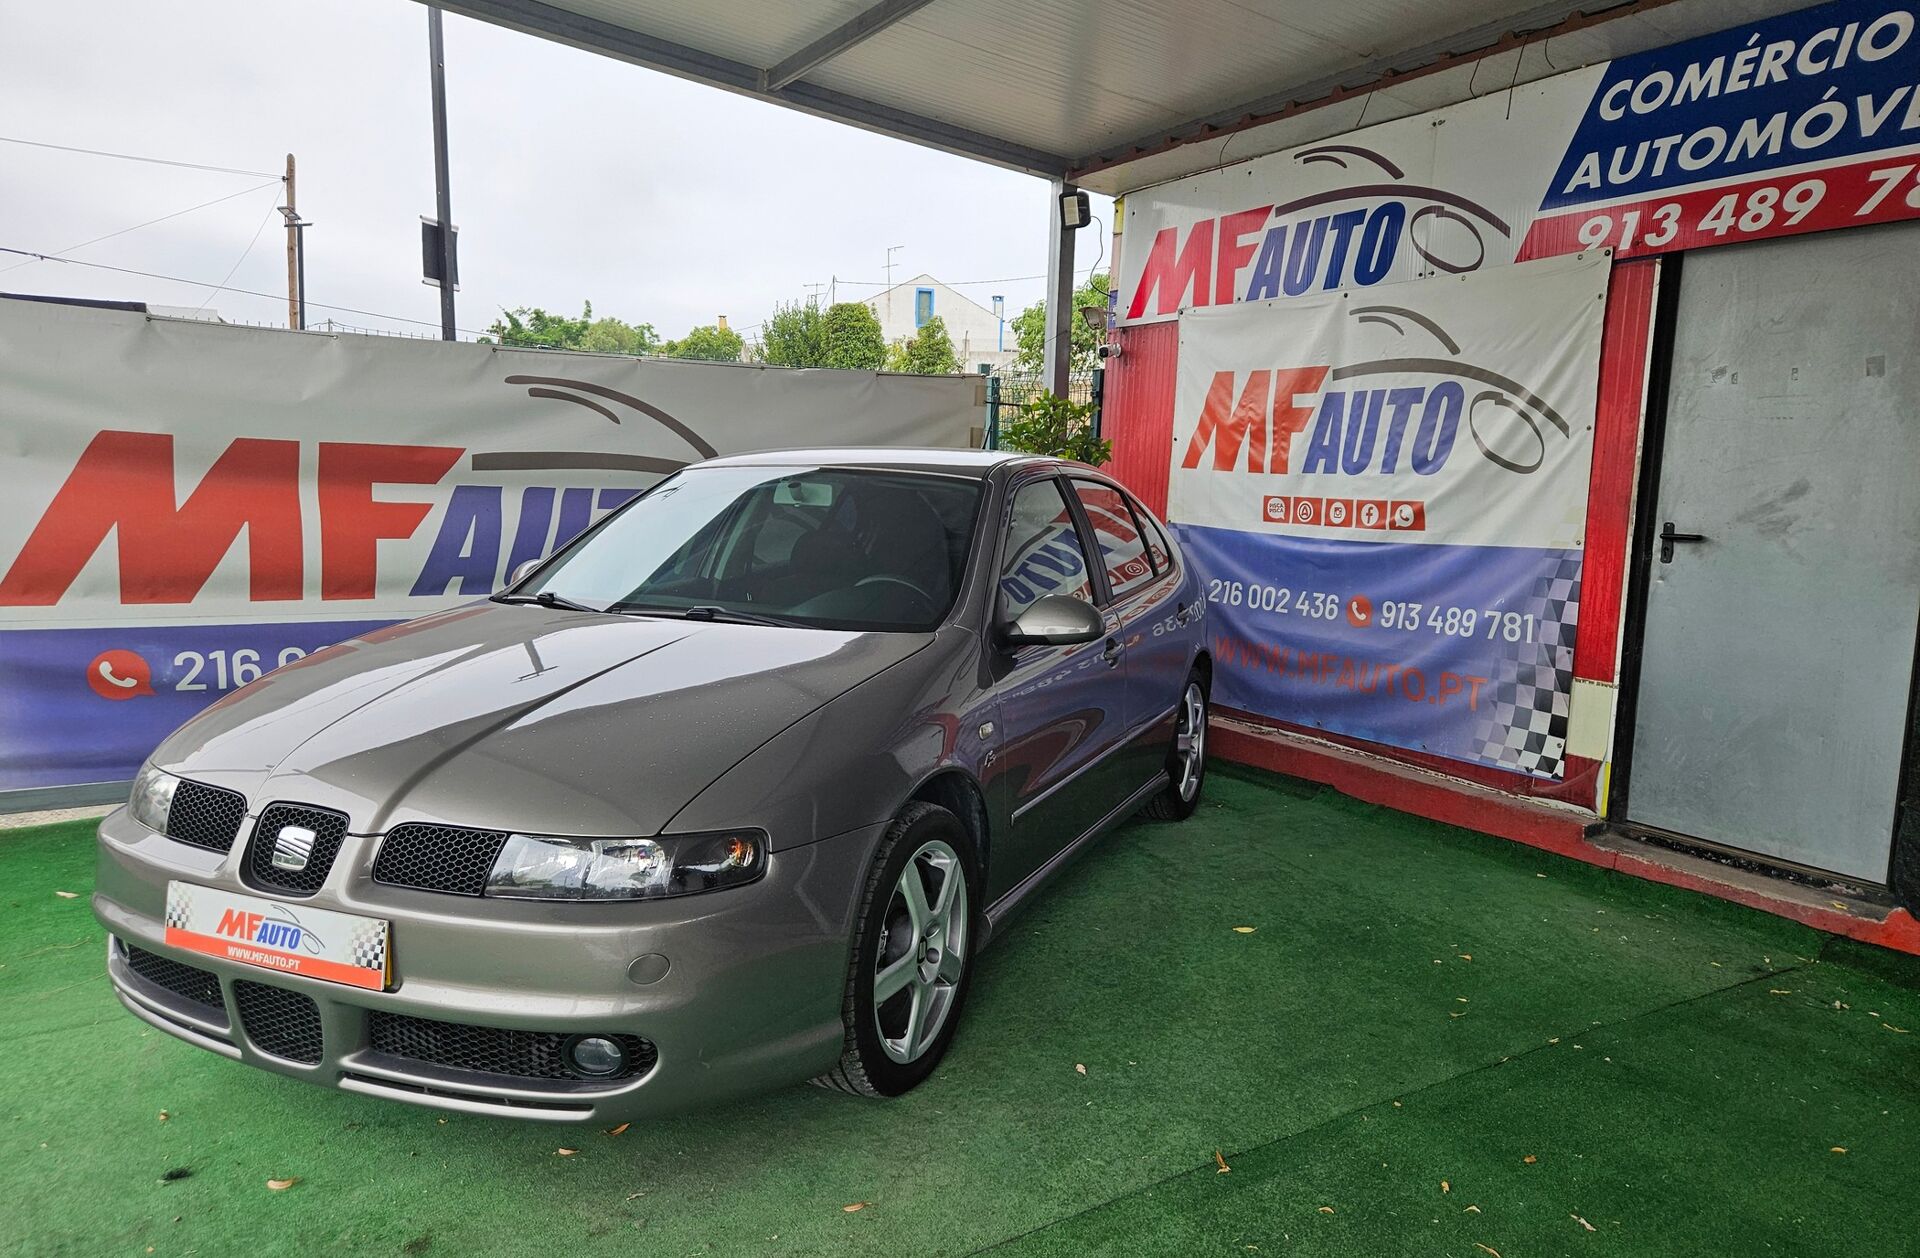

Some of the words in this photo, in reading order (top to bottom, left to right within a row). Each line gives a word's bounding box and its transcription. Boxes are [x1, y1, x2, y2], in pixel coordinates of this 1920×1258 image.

[1599, 11, 1915, 121] COMÉRCIO
[1577, 202, 1683, 251] 913
[1697, 179, 1827, 236] 489
[1208, 579, 1243, 606] 216
[1248, 584, 1291, 614] 002
[1296, 591, 1339, 620] 436
[1381, 600, 1423, 631] 913
[1427, 605, 1477, 637] 489
[1484, 610, 1535, 643] 781
[174, 648, 262, 691] 216
[1215, 634, 1488, 711] WWW.MFAUTO.PT
[227, 945, 301, 970] WWW.MFAUTO.PT
